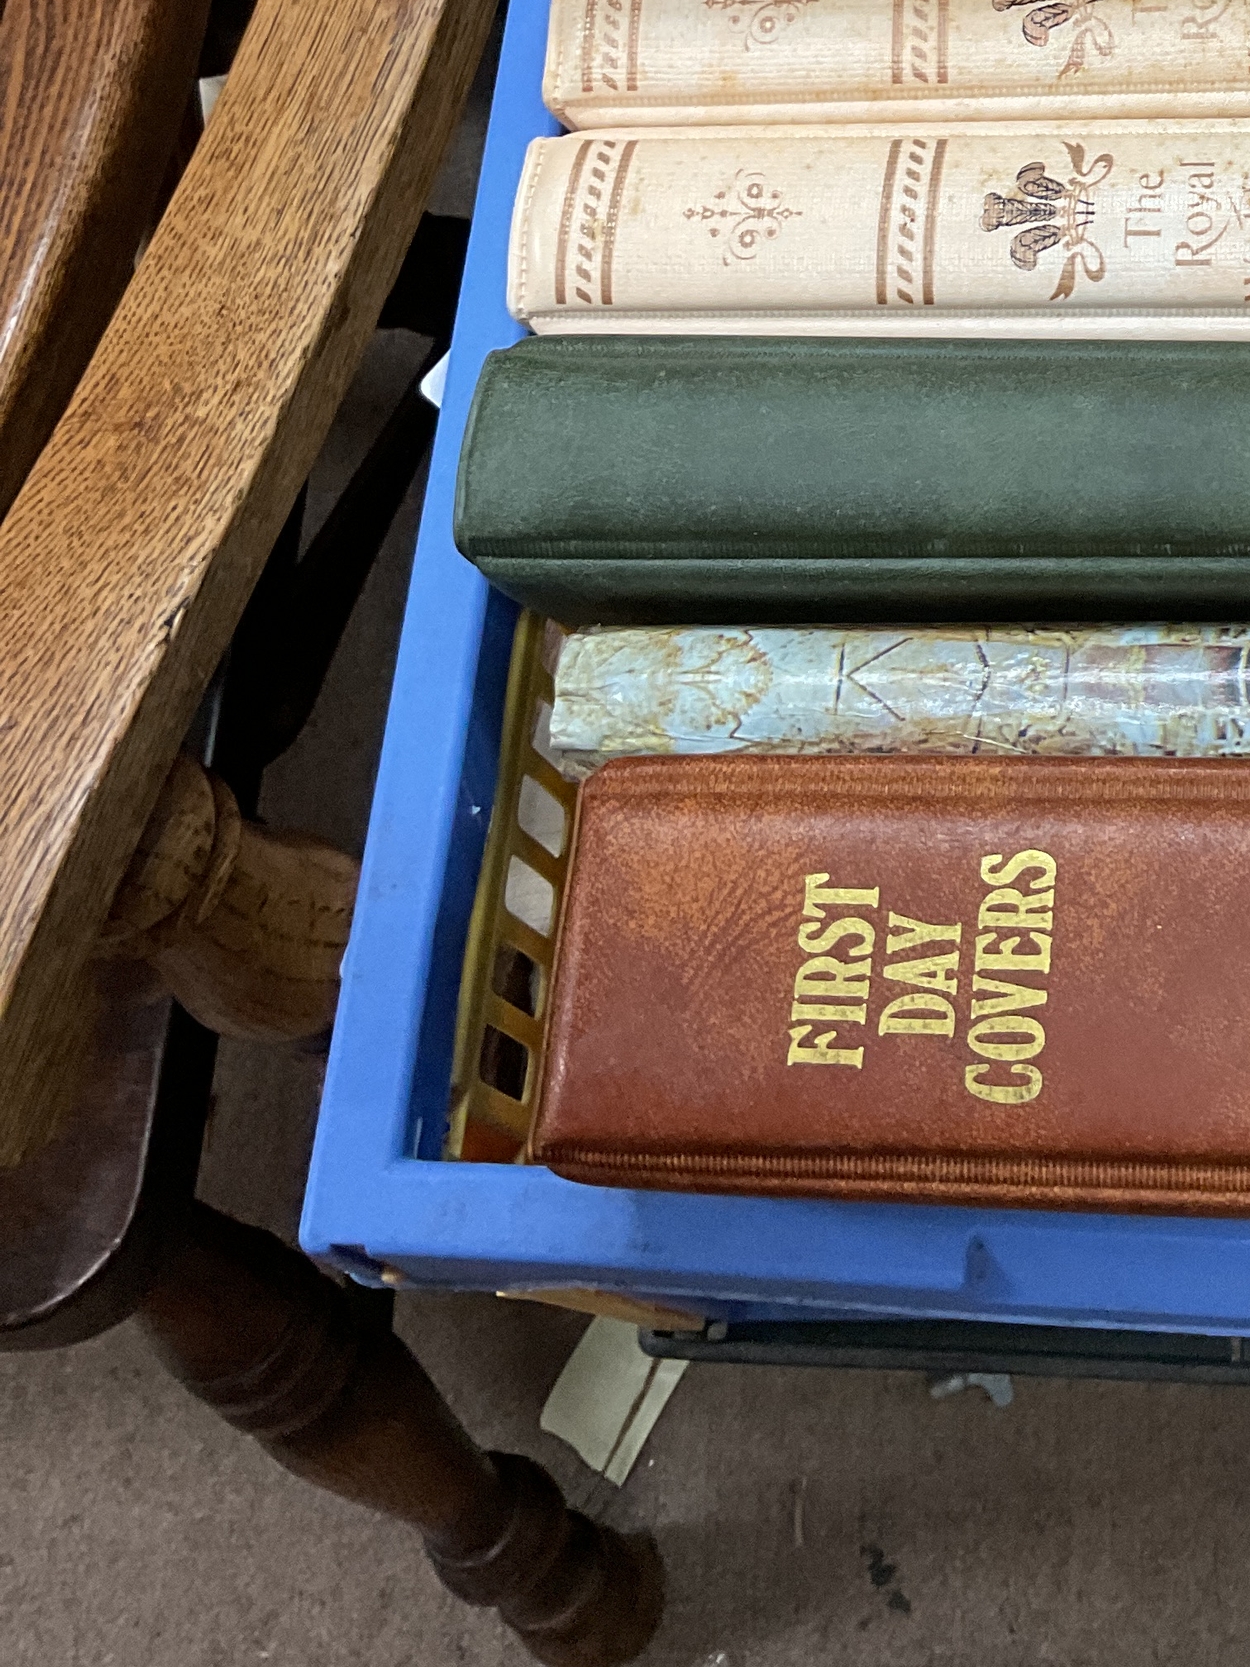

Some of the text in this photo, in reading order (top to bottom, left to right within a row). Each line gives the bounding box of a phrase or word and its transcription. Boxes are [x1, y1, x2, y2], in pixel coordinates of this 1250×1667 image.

[1123, 170, 1165, 249] The
[1175, 159, 1244, 268] Royal
[787, 872, 880, 1069] FIRST
[878, 911, 962, 1038] DAY
[964, 848, 1057, 1104] COVERS
